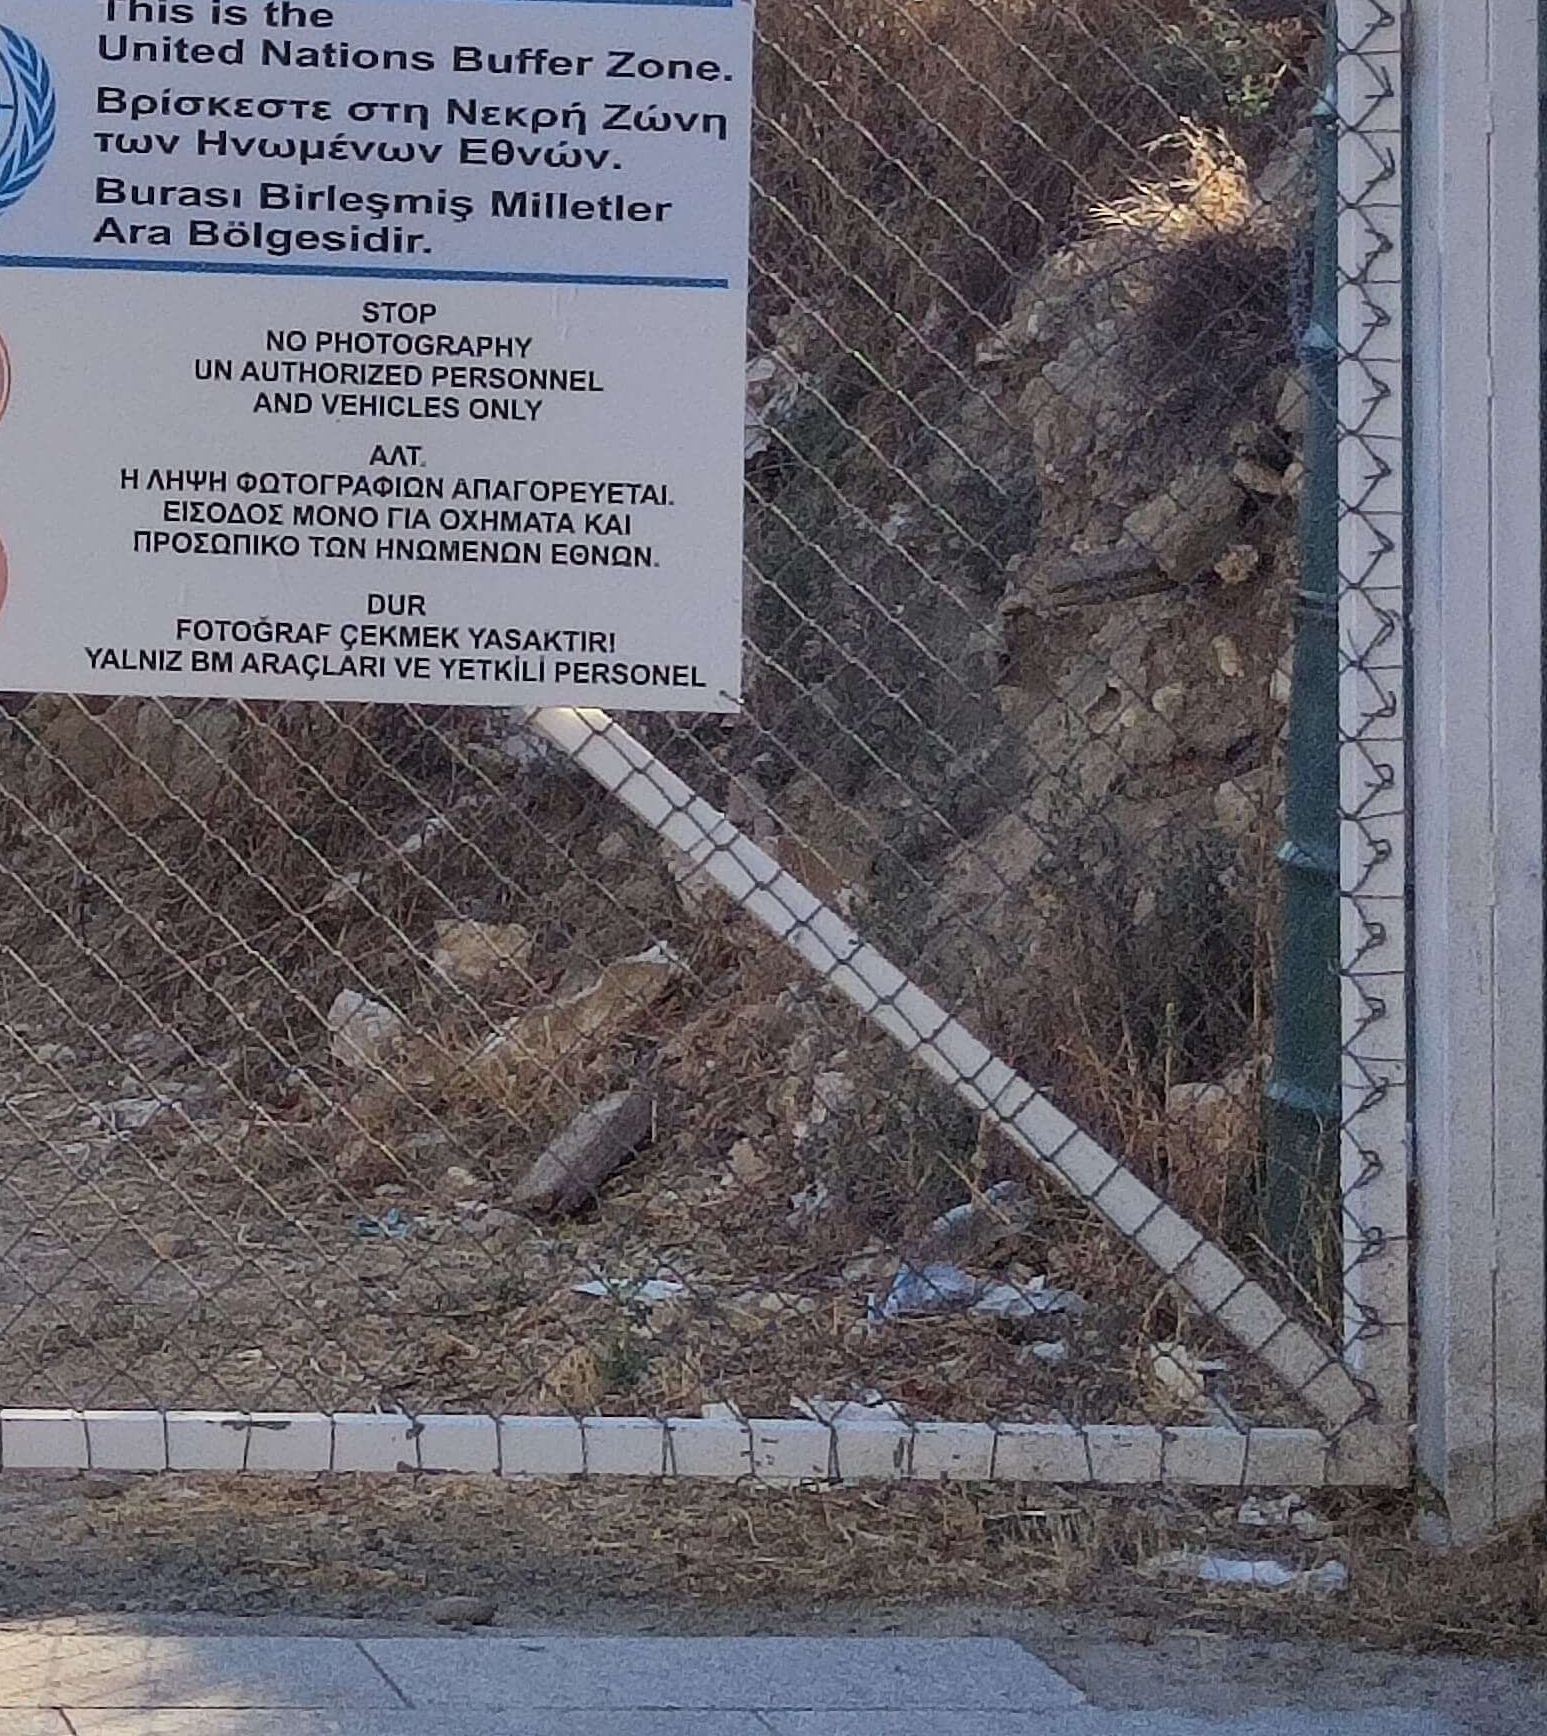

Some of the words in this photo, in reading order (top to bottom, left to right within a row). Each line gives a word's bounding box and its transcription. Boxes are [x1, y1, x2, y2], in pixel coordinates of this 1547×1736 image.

[212, 0, 247, 25] is
[264, 1, 333, 27] the
[99, 35, 244, 65] United
[262, 39, 434, 71] Nations
[453, 46, 593, 76] Buffer
[606, 51, 732, 81] Zone.
[97, 87, 331, 121] Βρίσκεστε
[348, 102, 428, 130] στη
[447, 99, 586, 135] Νεκρή
[602, 104, 726, 140] Ζώνη
[94, 133, 179, 154] των
[198, 129, 443, 165] Ηνωμένων
[460, 138, 621, 169] Εθνών.
[96, 177, 240, 208] Burası
[260, 183, 473, 223] Birleşmiş
[492, 191, 672, 222] Milletler
[93, 217, 170, 245] Ara
[190, 220, 431, 256] Bölgesidir.
[363, 302, 436, 324] STOP
[267, 330, 306, 351] NO
[316, 331, 532, 358] PHOTOGRAPHY
[195, 359, 232, 380] UN
[240, 361, 422, 385] AUTHORIZED
[432, 366, 604, 391] PERSONNEL
[253, 392, 312, 413] AND
[322, 394, 459, 418] VEHICLES
[470, 399, 542, 421] ONLY
[146, 469, 226, 492] ΛΗΨΗ
[237, 472, 443, 498] ΦΩΤΟΓΡΑΦΙΩΝ
[164, 501, 283, 525] ΕΙΣΟΔΟΣ
[294, 505, 378, 527] ΜΟΝΟ
[388, 507, 430, 529] ΓΙΑ
[440, 509, 575, 533] ΟΧΗΜΑΤΑ
[585, 514, 630, 535] ΚΑΙ
[134, 531, 299, 556] ΠΡΟΣΩΠΙΚΟ
[308, 536, 365, 559] ΤΩΝ
[376, 538, 540, 563] ΗΝΩΜΕΝΩΝ
[552, 544, 659, 567] ΕΘΝΩΝ.
[368, 594, 426, 616] DUR
[177, 616, 331, 644] FOTOĞRAF
[340, 624, 459, 651] ÇEKMEK
[468, 627, 615, 653] YASAKTIR!
[84, 647, 182, 671] YALNIZ
[192, 651, 232, 672] BM
[241, 653, 385, 681] ARAÇLARI
[394, 657, 430, 678] VE
[439, 655, 544, 682] YETKİLİ
[555, 662, 707, 687] PERSONEL
